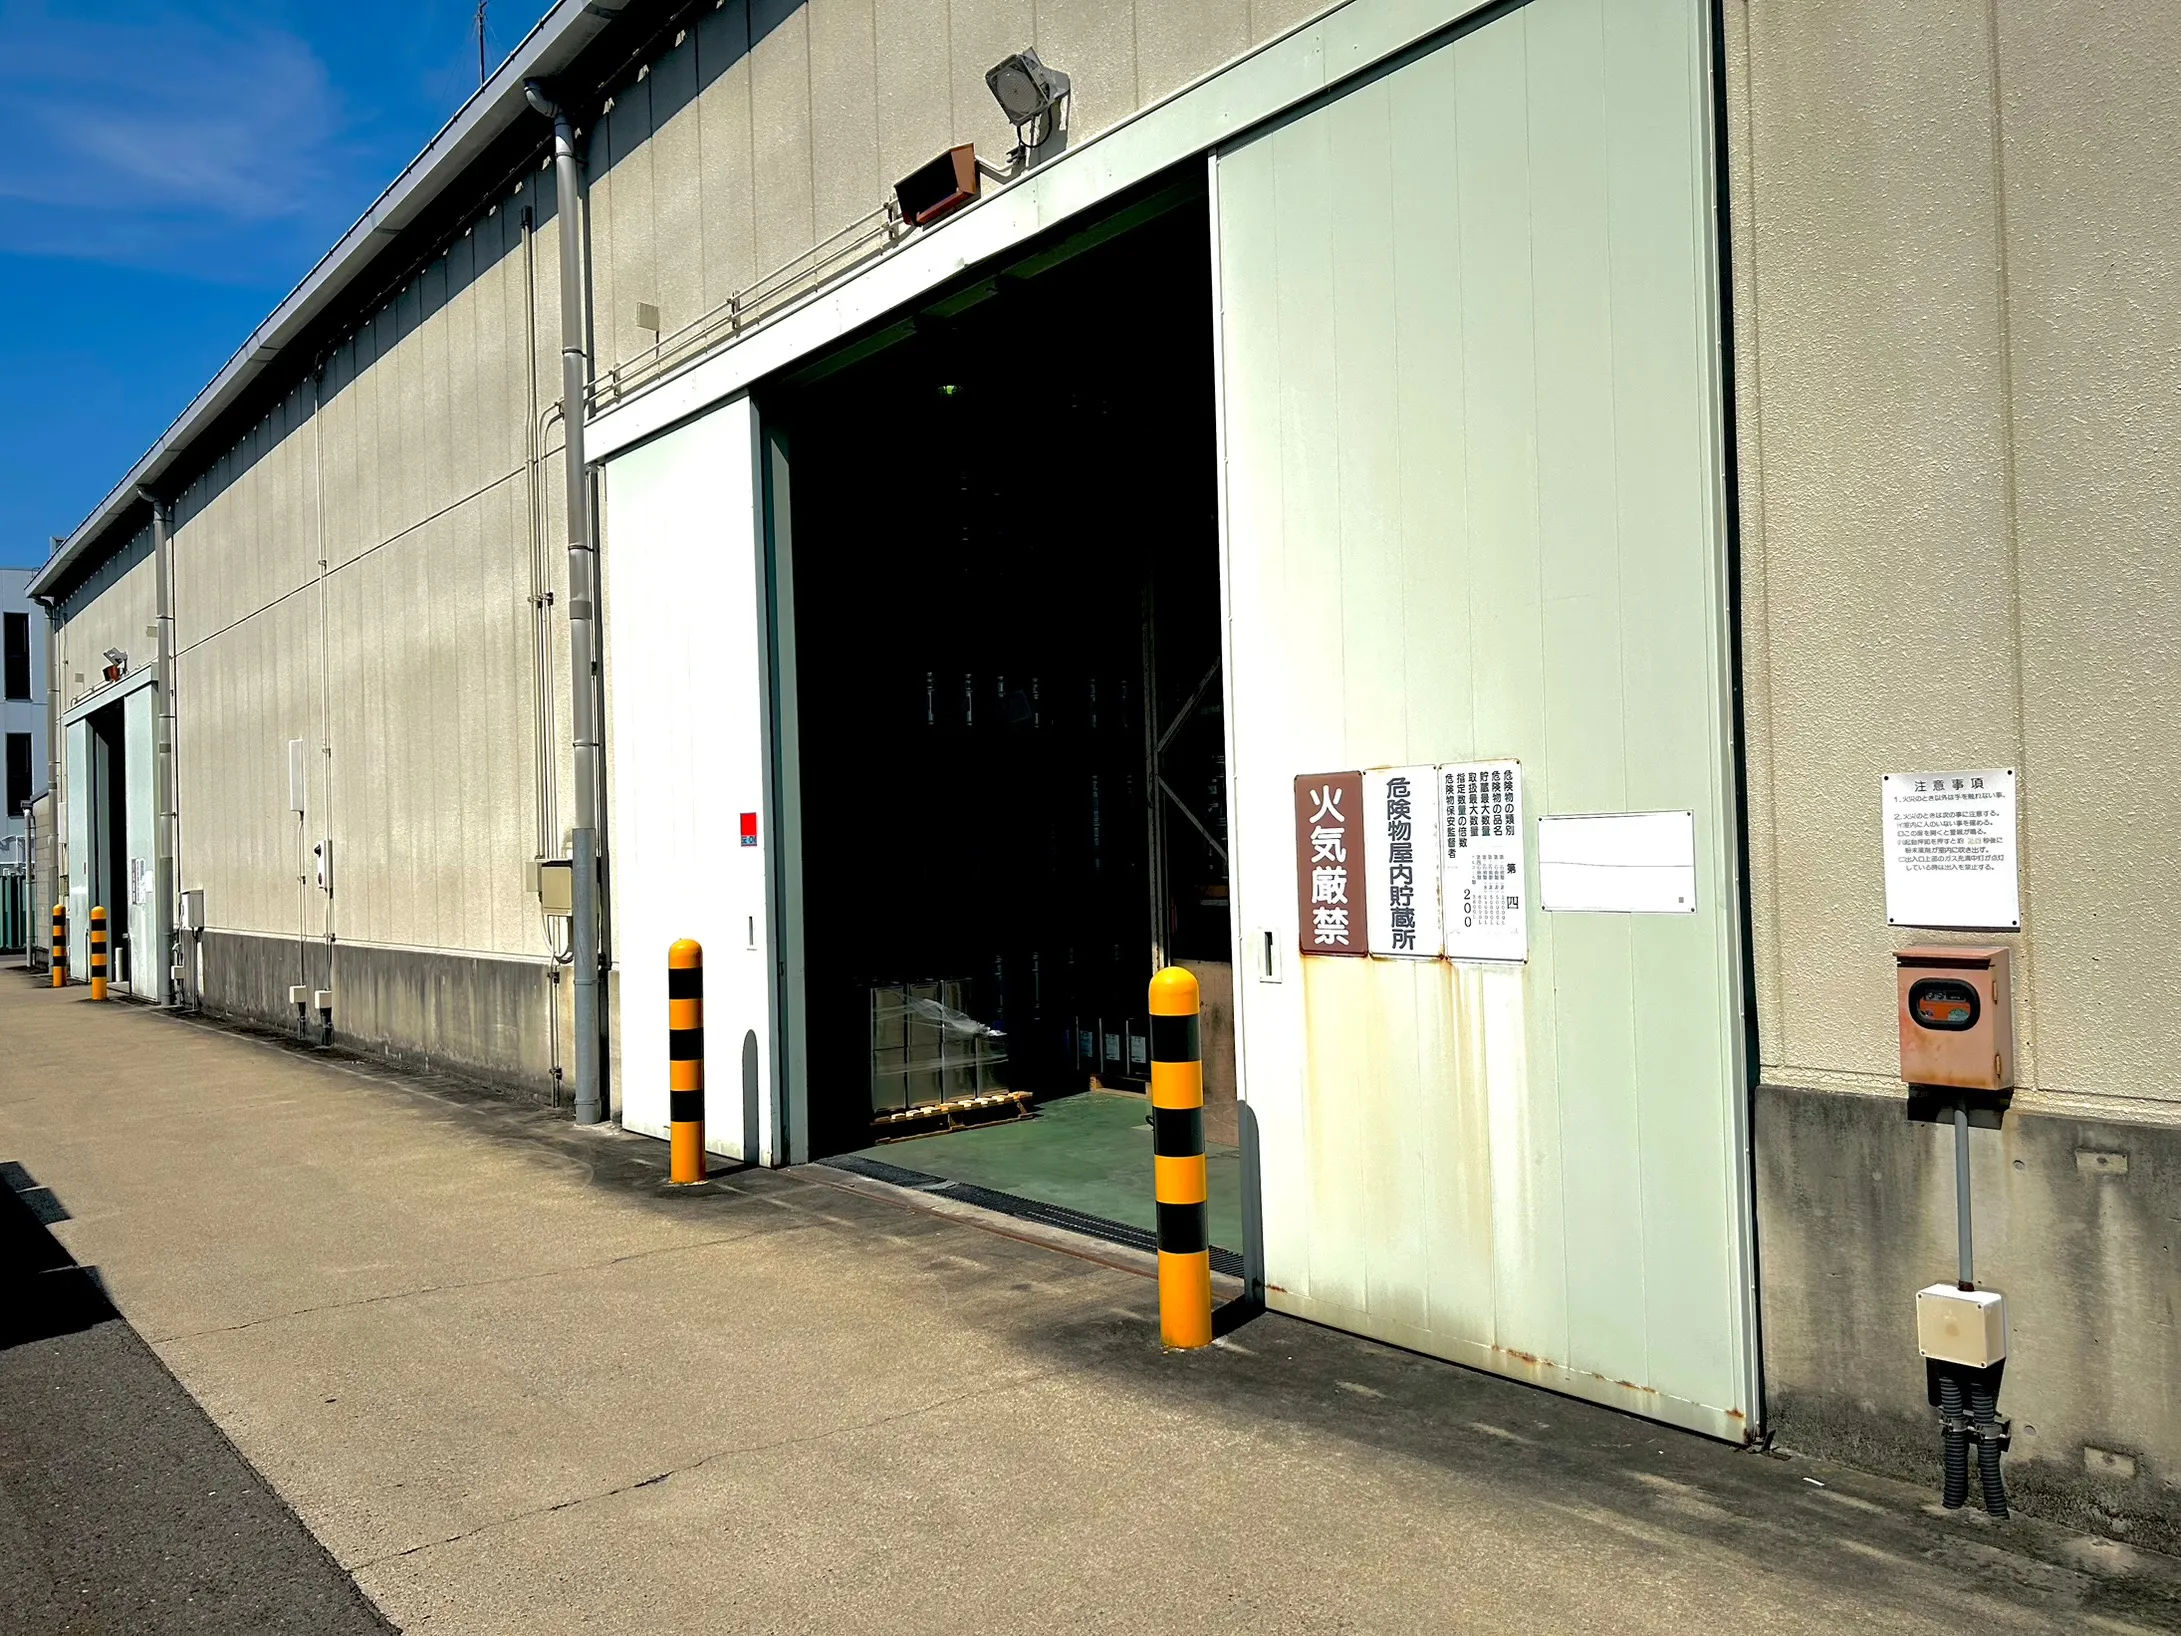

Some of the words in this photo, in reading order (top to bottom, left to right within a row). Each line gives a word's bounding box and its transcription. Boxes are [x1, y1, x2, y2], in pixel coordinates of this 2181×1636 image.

[1445, 774, 1457, 859] 危険物保安監督者
[1456, 773, 1468, 848] 指定数量の倍数
[1467, 772, 1479, 837] 取扱最大数量
[1479, 771, 1491, 837] 貯蔵最大数量
[1491, 770, 1503, 837] 危険物の品名
[1503, 769, 1515, 836] 危険物の類別
[1914, 777, 1985, 792] 注意事項
[1309, 784, 1350, 946] 火気厳禁
[1386, 777, 1416, 950] 危険物屋内貯蔵所
[1463, 888, 1472, 927] 200
